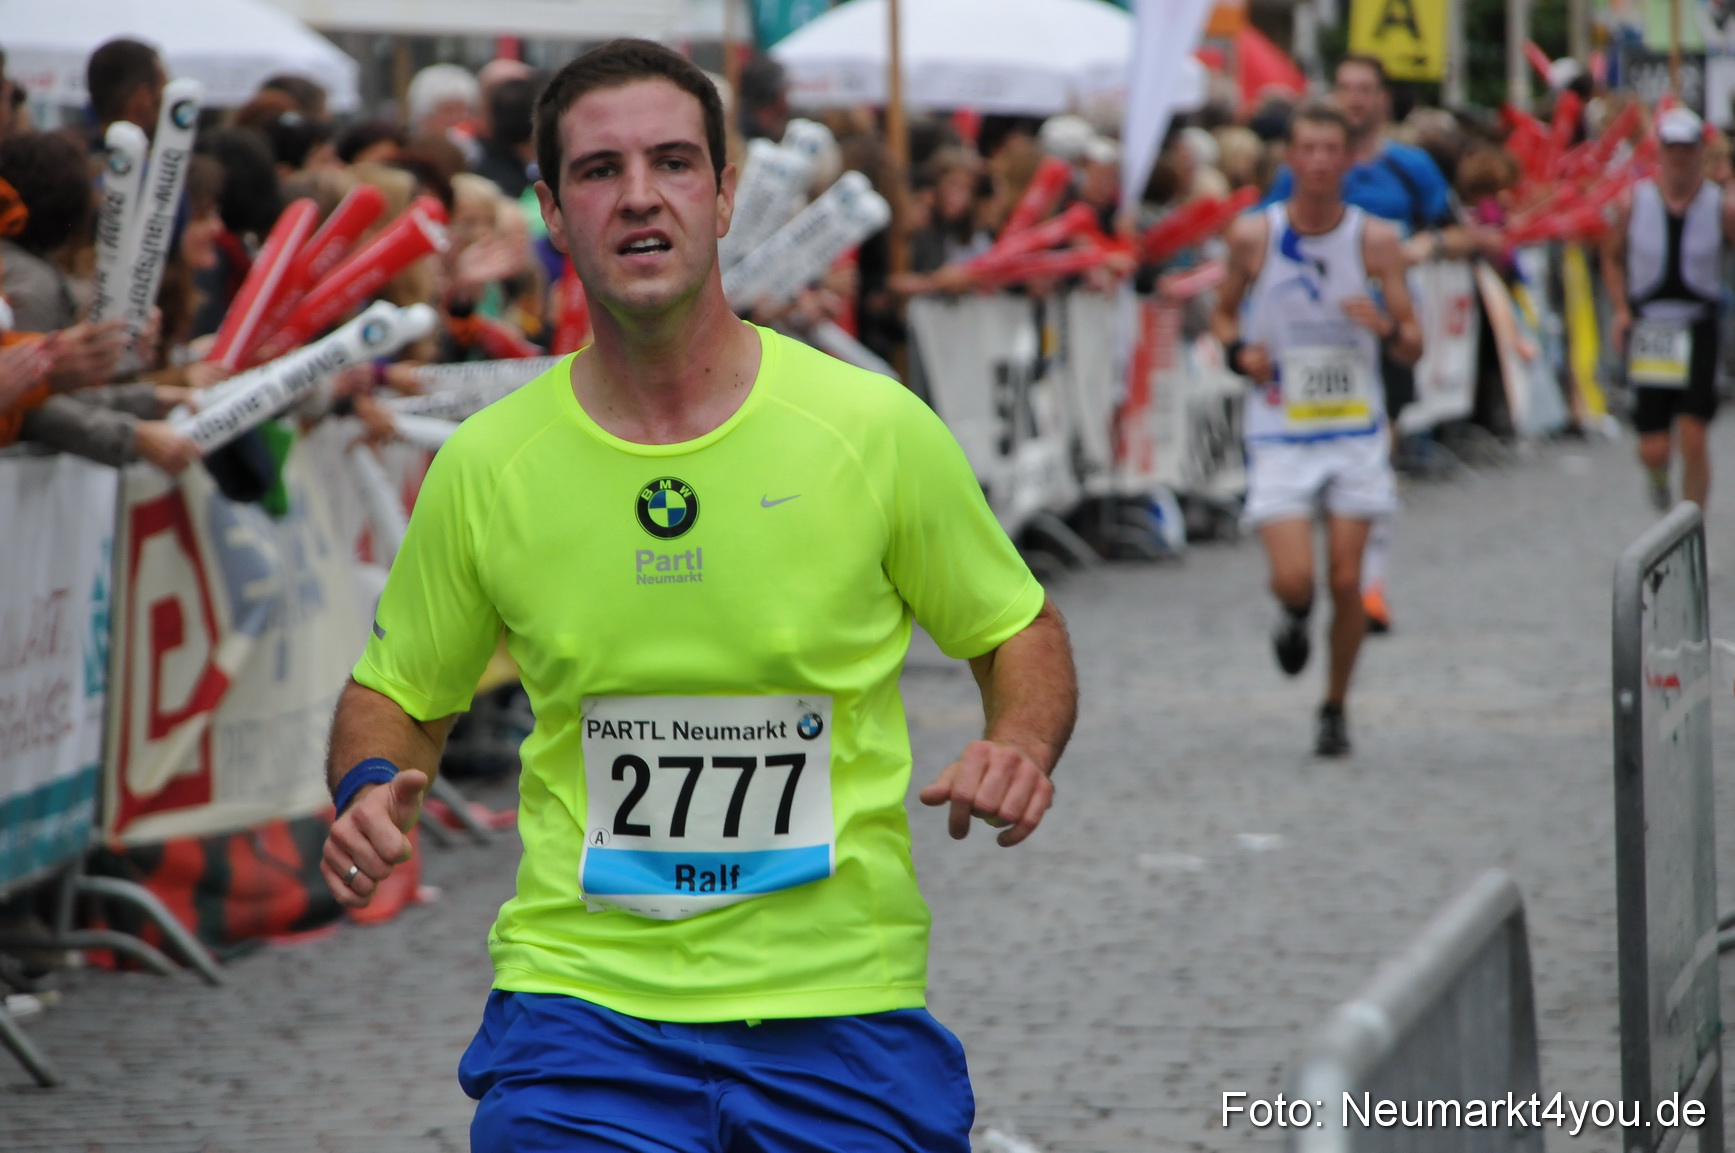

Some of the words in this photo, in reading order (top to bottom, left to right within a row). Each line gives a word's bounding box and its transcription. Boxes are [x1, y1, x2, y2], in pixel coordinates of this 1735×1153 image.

[1374, 0, 1422, 39] A
[641, 479, 692, 501] BMW
[635, 547, 703, 573] Partl
[636, 571, 703, 585] Neumarkt
[587, 719, 666, 740] PARTL
[672, 719, 787, 741] Neumarkt
[611, 753, 806, 838] 2777
[594, 831, 604, 845] A
[675, 864, 740, 892] Ralf
